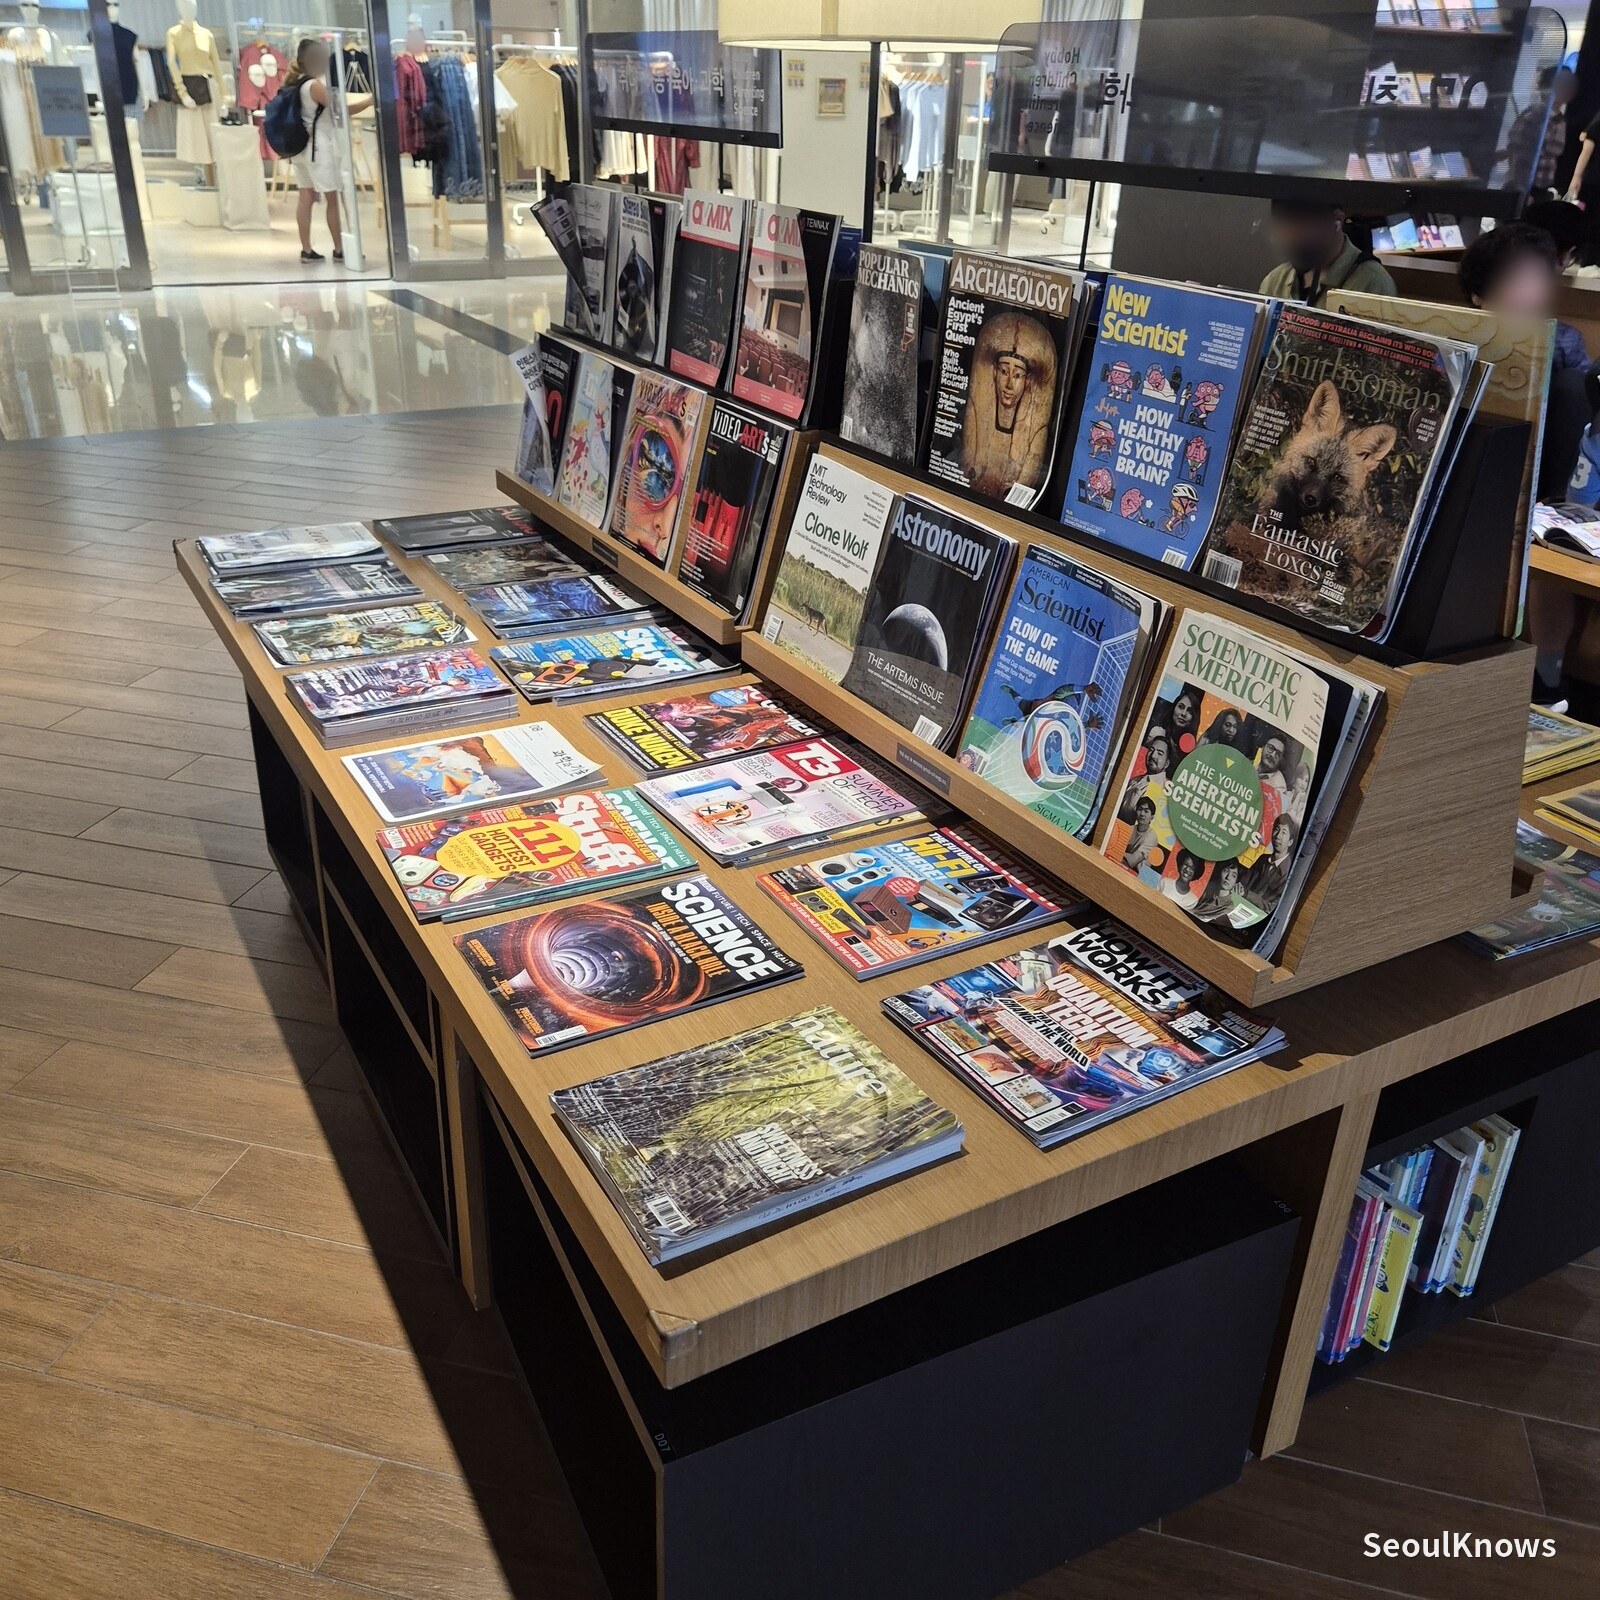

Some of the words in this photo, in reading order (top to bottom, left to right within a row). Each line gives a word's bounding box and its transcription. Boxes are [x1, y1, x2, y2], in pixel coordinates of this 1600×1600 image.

[859, 249, 909, 278] POPULAR
[858, 267, 920, 300] MECHANICS
[951, 257, 1071, 313] ARCHAEOLOGY
[947, 307, 983, 325] Egypt's
[949, 297, 985, 314] Ancient
[1105, 284, 1151, 318] New
[945, 329, 976, 346] Queen
[946, 319, 969, 333] First
[1101, 312, 1188, 357] Scientist
[1320, 320, 1357, 337] AUSTRALIA
[1358, 331, 1392, 346] RECLAIMS
[1404, 343, 1421, 354] WILD
[942, 363, 964, 375] Ohio's
[943, 348, 959, 358] Who
[943, 356, 958, 366] Built
[941, 370, 968, 383] Serpent
[941, 378, 968, 390] Mound?
[1265, 332, 1441, 410] Smithsonian
[1135, 404, 1173, 430] HOW
[1117, 418, 1184, 452] HEALTHY
[811, 462, 828, 478] MIT
[1118, 437, 1131, 456] IS
[1134, 442, 1176, 470] YOUR
[1115, 456, 1170, 487] BRAIN?
[806, 486, 831, 507] Review
[809, 474, 847, 504] Technology
[1269, 508, 1284, 520] THE
[804, 511, 841, 546] Clone
[842, 529, 870, 561] Wolf
[890, 500, 992, 581] Astronomy
[1250, 513, 1344, 565] Fantastic
[1028, 565, 1071, 591] AMERICAN
[1264, 542, 1322, 583] Foxes
[1325, 570, 1336, 578] OF
[1319, 587, 1346, 603] RAINIER
[1322, 578, 1348, 594] MOUNT
[1018, 576, 1107, 642] Scientist
[1009, 616, 1041, 643] FLOW
[1040, 631, 1058, 651] OF
[610, 627, 696, 675] Stuff
[1004, 635, 1025, 657] THE
[1025, 646, 1060, 676] GAME
[1009, 659, 1019, 669] Cup
[1182, 623, 1302, 697] SCIENTIFIC
[866, 651, 884, 671] THE
[883, 661, 919, 690] ARTEMIS
[918, 682, 945, 705] ISSUE
[1174, 649, 1295, 723] AMERICAN
[601, 708, 654, 735] DUKE
[629, 732, 694, 768] NUKEM
[742, 758, 776, 779] BEATERS
[752, 756, 772, 767] BBQ
[779, 742, 854, 778] T3
[829, 777, 856, 790] OF
[847, 789, 889, 813] TECH
[844, 772, 906, 810] SUMMER
[1195, 759, 1216, 779] THE
[1218, 772, 1254, 801] YOUNG
[1176, 768, 1260, 826] AMERICAN
[1034, 803, 1060, 827] SIGMA
[1060, 819, 1074, 832] XI
[1162, 780, 1262, 849] SCIENTISTS
[1180, 814, 1191, 824] Meet
[486, 827, 534, 869] HOTTEST
[507, 820, 577, 865] 111
[540, 793, 647, 872] Stuff
[617, 823, 645, 847] LIFESTYLE
[645, 818, 660, 828] TECH
[656, 831, 676, 845] SPACE
[885, 842, 909, 853] IS
[1208, 838, 1223, 850] future
[449, 844, 466, 857] picks
[463, 845, 481, 858] most
[473, 857, 494, 875] wanted
[469, 831, 515, 873] GADGETS
[896, 850, 948, 882] HERE!
[901, 834, 979, 880] HI-FI
[928, 832, 950, 844] THE
[942, 842, 981, 866] FUTURE
[973, 864, 990, 872] OF
[643, 901, 684, 927] INSIDE
[665, 924, 690, 934] A
[709, 891, 736, 909] FUTURE
[731, 912, 753, 927] TECH
[748, 929, 773, 947] SPACE
[769, 949, 796, 968] HEALTH
[653, 880, 784, 982] SCIENCE
[671, 931, 713, 958] BLACK
[814, 926, 841, 946] BARGAIN
[834, 945, 864, 969] SPEAKERS
[694, 954, 732, 978] HOLE
[1065, 931, 1171, 1011] WORKS
[1083, 924, 1161, 976] HOW
[1148, 971, 1193, 998] IT
[1032, 1010, 1058, 1027] THAT
[1052, 1026, 1077, 1042] WILL
[1037, 997, 1109, 1043] TECH
[1041, 971, 1158, 1051] QUANTUM
[998, 996, 1041, 1026] CHANGE
[1033, 1023, 1059, 1040] THE
[1053, 1039, 1093, 1066] WORLD
[1165, 1018, 1201, 1040] FILES?
[788, 1015, 893, 1098] nature
[731, 1129, 774, 1159] AND
[752, 1120, 824, 1181] SWEETNESS
[751, 1151, 799, 1187] MIGHT
